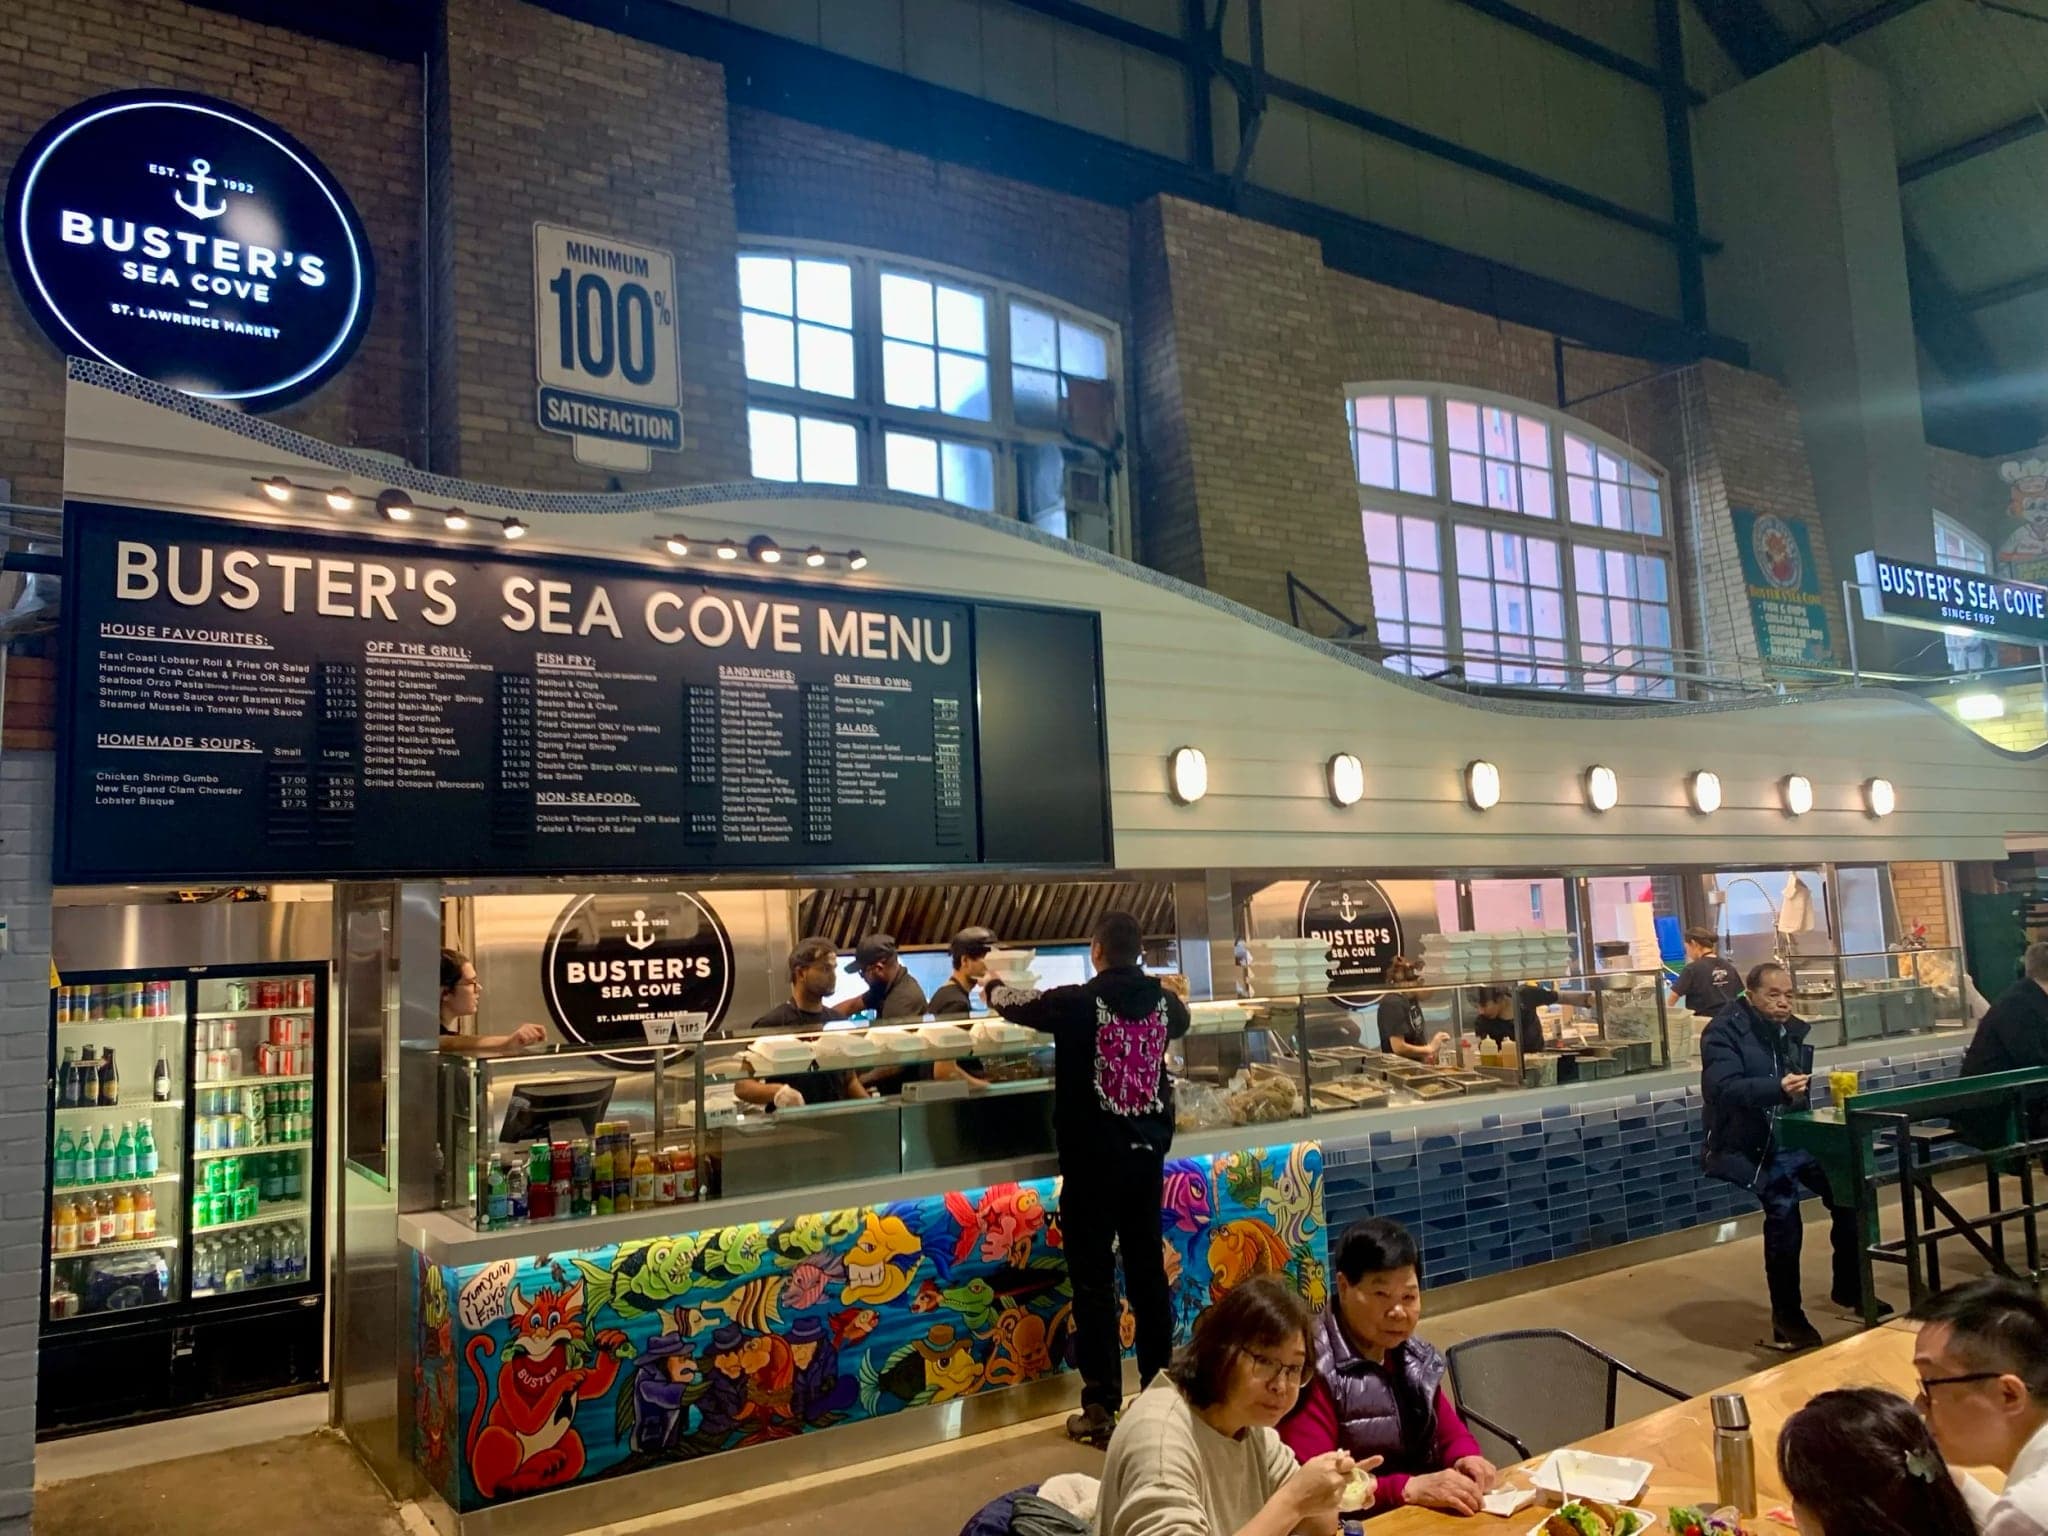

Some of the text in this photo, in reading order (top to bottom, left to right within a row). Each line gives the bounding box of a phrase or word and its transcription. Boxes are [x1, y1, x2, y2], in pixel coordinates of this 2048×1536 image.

[149, 164, 254, 194] EST. 1992
[61, 210, 326, 286] BUSTER'S
[567, 241, 648, 278] MINIMUM
[122, 261, 270, 302] SEA COVE
[112, 304, 280, 338] ST. LAWRENCE MARKET
[548, 397, 672, 440] SATISFACTION
[1878, 563, 2044, 619] BUSTER'S SEA COVE
[116, 540, 951, 665] BUSTER'S SEA COVE MENU
[1941, 606, 1995, 624] SINCE 1992
[100, 623, 269, 647] HOUSE FAVOURITES:
[366, 642, 472, 658] OFF THE GRILL:
[99, 651, 124, 661] East
[127, 653, 158, 663] Coast
[160, 655, 200, 666] Lobster
[202, 658, 222, 668] Roll
[236, 660, 260, 670] Fries
[264, 662, 280, 671] OR
[282, 663, 310, 674] Salad
[537, 653, 596, 667] FISH FRY:
[99, 664, 156, 675] Handmade
[158, 667, 184, 676] Crab
[186, 669, 218, 679] Cakes
[232, 671, 257, 681] Fries
[260, 673, 276, 682] OR
[278, 674, 306, 684] Salad
[366, 668, 465, 681] Grilled Atlantic Salmon
[719, 666, 795, 680] SANDWICHES:
[99, 676, 204, 688] Seafood Orzo Pasta
[366, 679, 437, 690] Grilled Calamari
[536, 679, 566, 688] Halibut
[576, 681, 599, 690] Chips
[834, 674, 912, 687] ON THEIR OWN:
[99, 688, 306, 706] Shrimp in Rose Sauce over Basmati Rice
[366, 690, 484, 704] Grilled Jumbo Tiger Shrimp
[99, 700, 303, 718] Steamed Mussels in Tomato Wine Sauce
[366, 701, 443, 712] Grilled Mahi-Mahi
[365, 712, 441, 723] Grilled Swordfish
[365, 724, 454, 735] Grilled Red Snapper
[536, 721, 661, 734] Fried Calamari ONLY (no sides)
[836, 723, 878, 732] SALADS:
[97, 734, 257, 750] HOMEMADE SOUPS:
[365, 735, 456, 746] Grilled Halibut Steak
[274, 748, 349, 759] Small Large
[365, 746, 460, 756] Grilled Rainbow Trout
[365, 757, 427, 767] Grilled Tilapia
[365, 768, 436, 777] Grilled Sardines
[96, 773, 219, 784] Chicken Shrimp Gumbo
[281, 776, 306, 785] $7.00
[329, 777, 354, 786] $8.50
[96, 785, 243, 796] New England Clam Chowder
[365, 780, 394, 788] Grilled
[396, 780, 433, 790] Octopus
[281, 788, 306, 797] $7.00
[329, 789, 354, 797] $8.50
[536, 793, 636, 803] NON-SEAFOOD:
[95, 797, 175, 807] Lobster Bisque
[281, 800, 307, 809] $7.75
[329, 800, 354, 809] $9.75
[1332, 947, 1376, 958] SEA COVE
[567, 956, 711, 984] BUSTER'S
[602, 983, 682, 998] SEA COVE
[612, 1012, 655, 1021] LAWRENCE
[680, 1023, 699, 1033] TIPS
